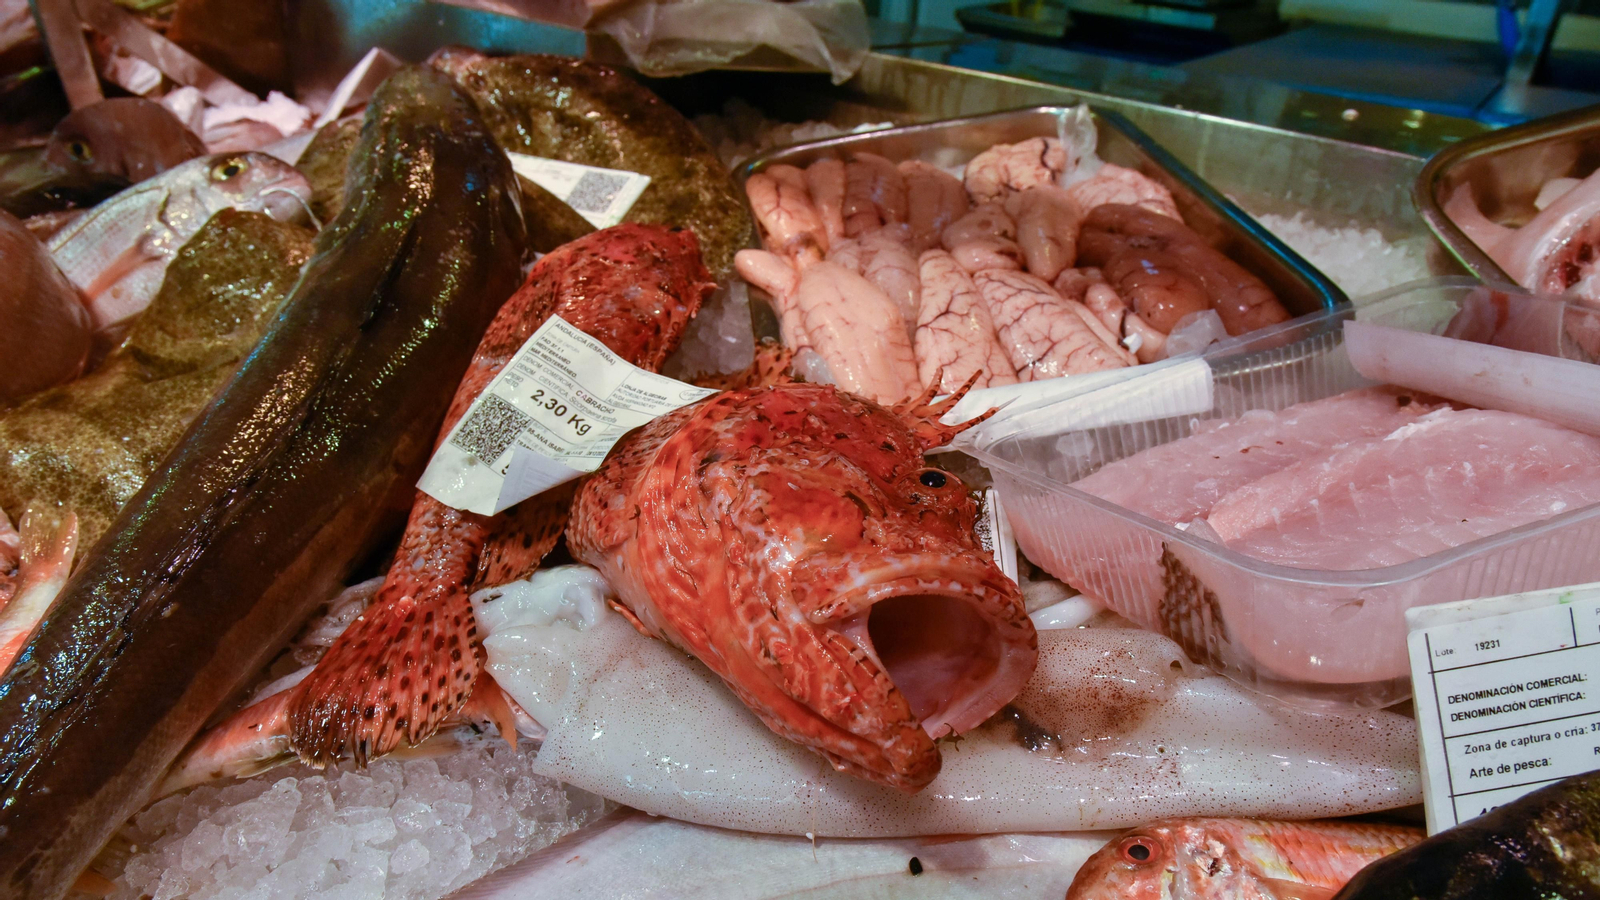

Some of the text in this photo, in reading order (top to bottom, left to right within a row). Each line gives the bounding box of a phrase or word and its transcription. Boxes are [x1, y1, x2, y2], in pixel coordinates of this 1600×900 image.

[586, 340, 616, 366] (ESPAÑA)
[509, 372, 524, 382] PESO
[530, 390, 568, 416] 2,30
[567, 414, 592, 436] Kg
[576, 390, 615, 414] CABRACHO
[1435, 640, 1500, 658] Lote: 19231
[1448, 674, 1588, 704] DENOMINACIÓN COMERCIAL:
[1450, 692, 1586, 722] DENOMINACIÓN CIENTÍFICA:
[1464, 744, 1492, 754] Zona
[1494, 740, 1508, 750] de
[1510, 734, 1552, 747] captura
[1470, 758, 1552, 779] Arte de pesca:
